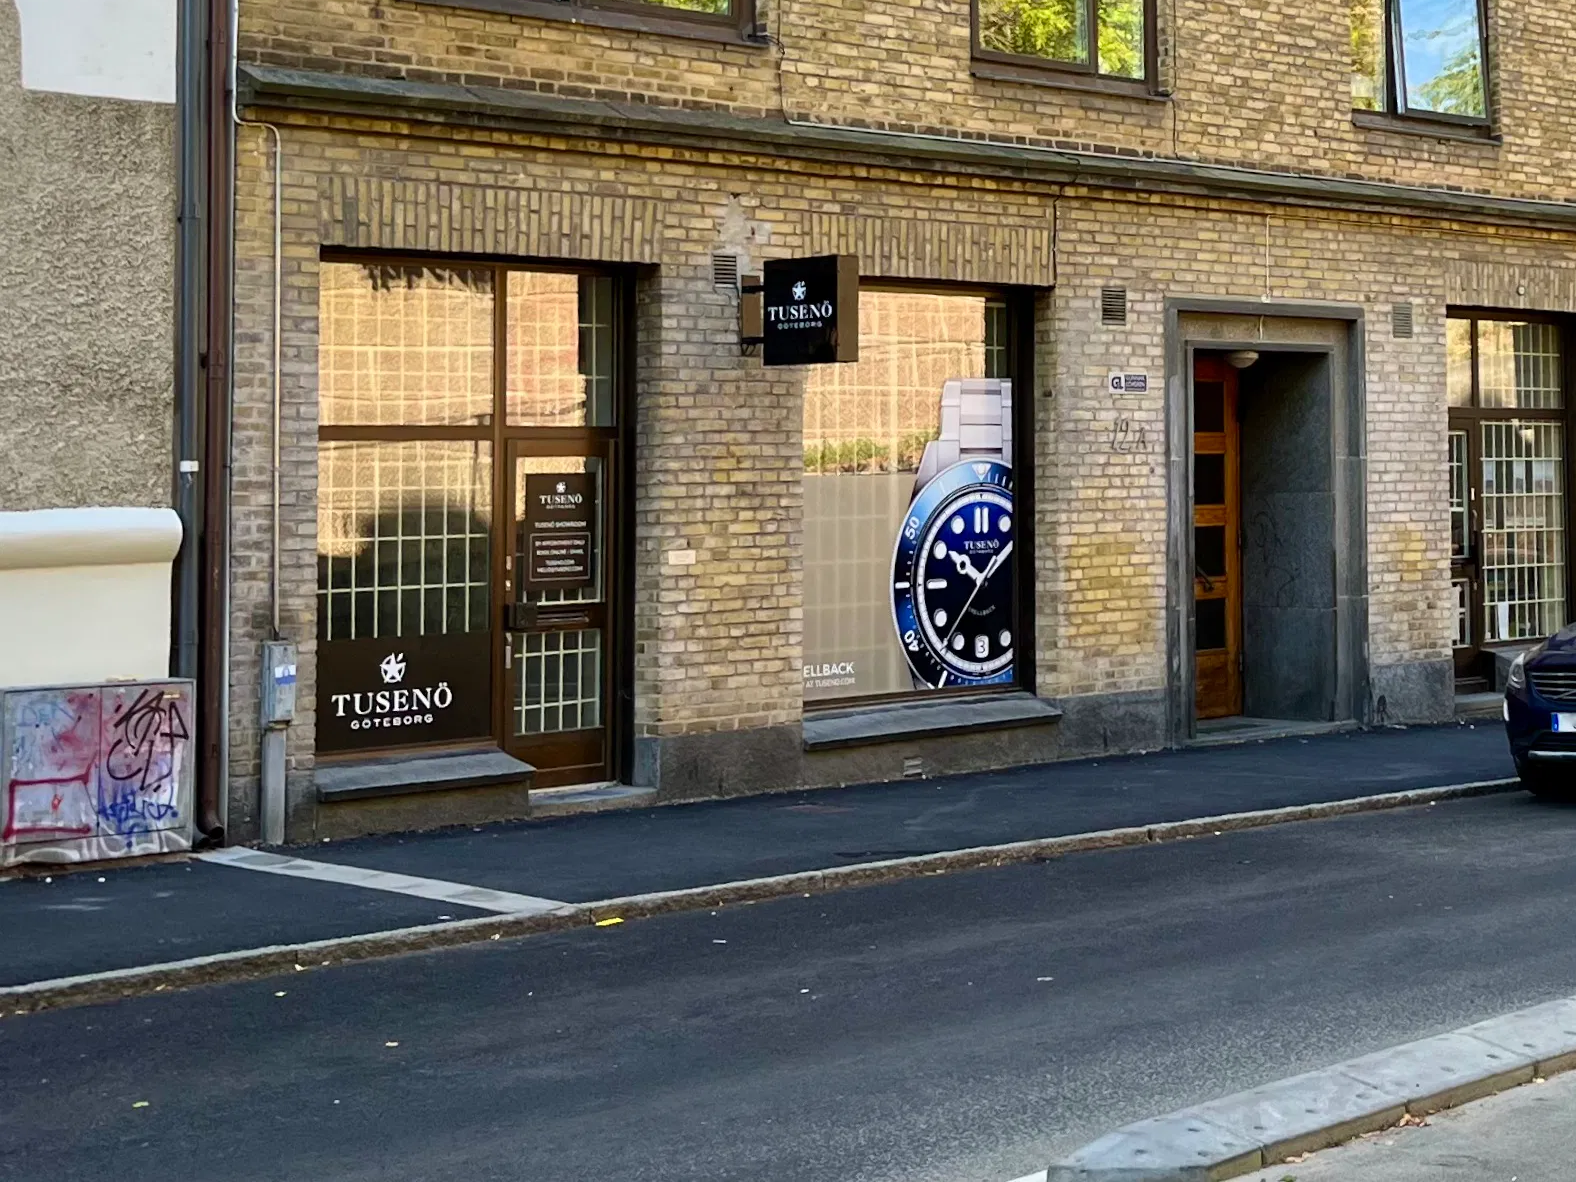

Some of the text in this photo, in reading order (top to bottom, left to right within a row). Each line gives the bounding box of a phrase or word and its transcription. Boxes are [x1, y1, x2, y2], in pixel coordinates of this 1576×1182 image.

[767, 300, 833, 321] TUSENÖ
[1111, 418, 1130, 452] 12
[539, 493, 583, 504] TUSENÖ
[904, 517, 920, 540] 50
[963, 539, 1000, 550] TUSENÖ
[904, 630, 920, 652] 40
[803, 661, 855, 678] ELLBACK
[331, 681, 453, 717] TUSENÖ
